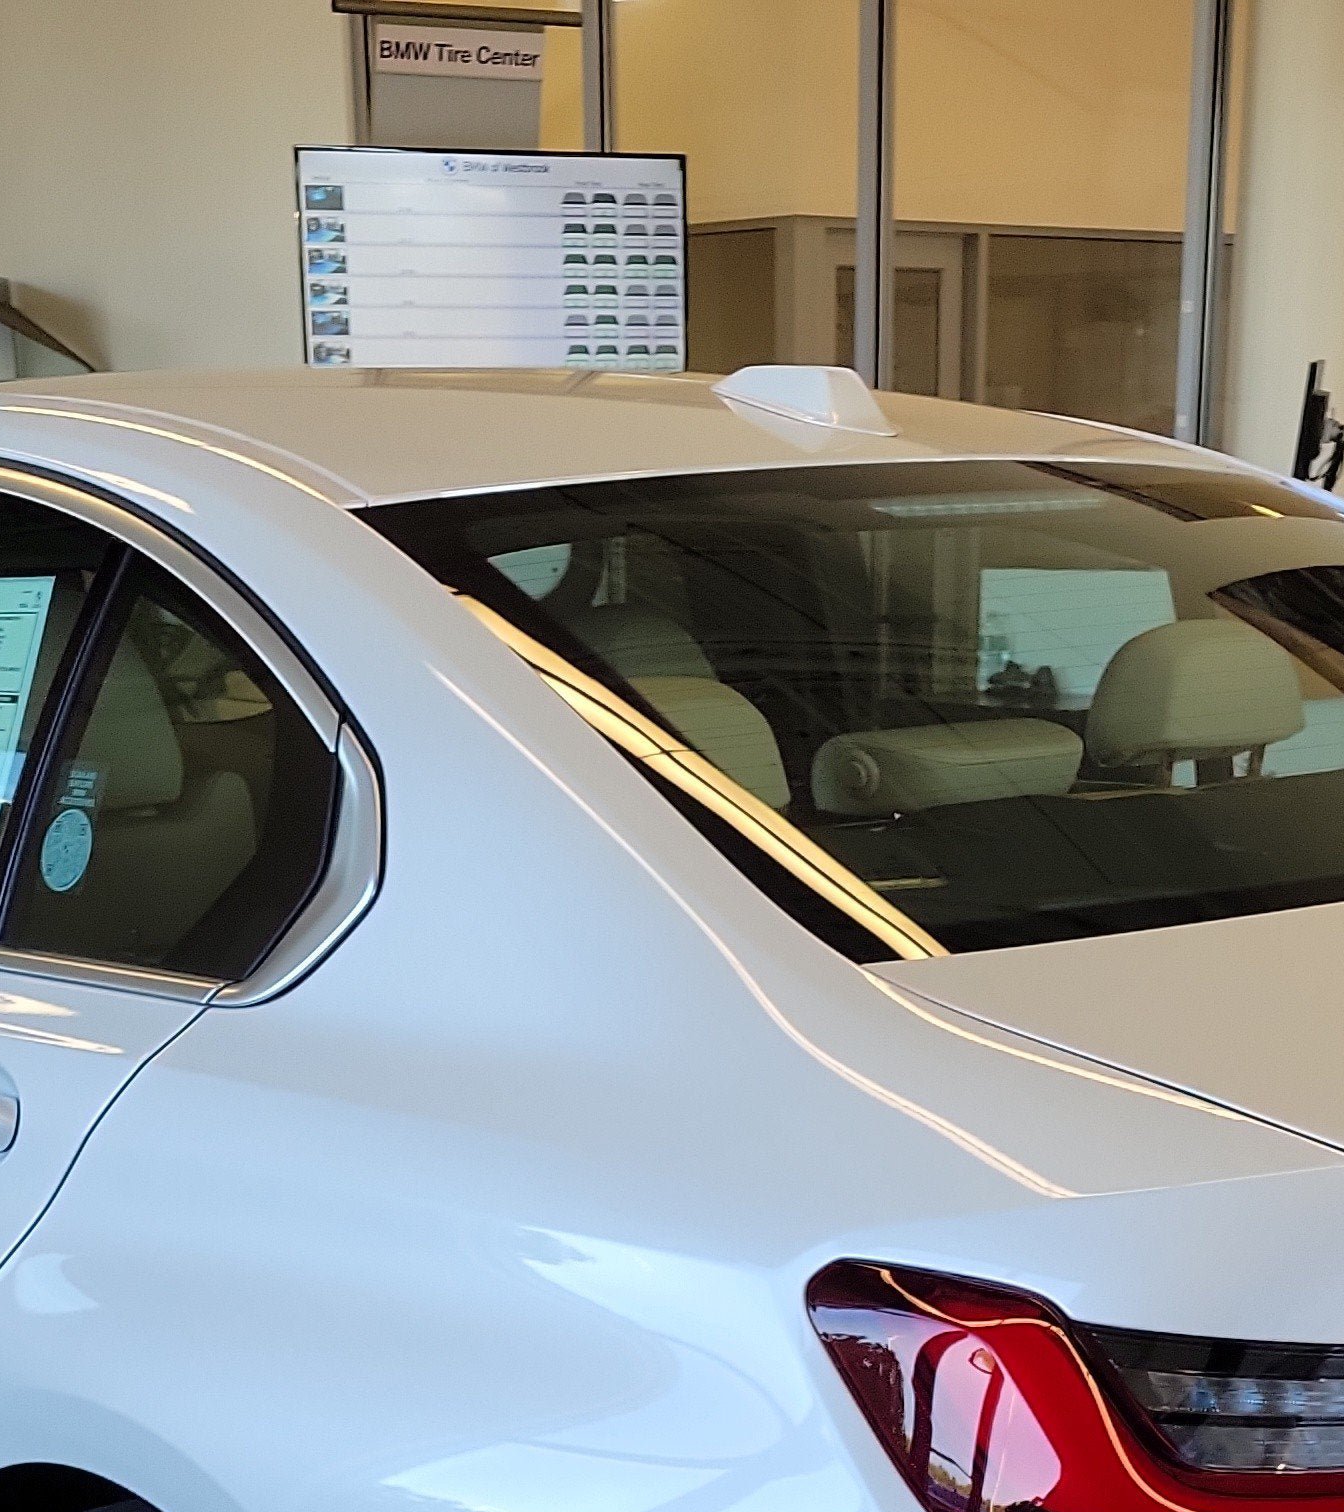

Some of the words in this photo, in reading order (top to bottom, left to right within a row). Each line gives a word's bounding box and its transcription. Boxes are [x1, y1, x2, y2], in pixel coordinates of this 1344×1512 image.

[379, 39, 431, 61] BMW
[433, 42, 472, 63] Tire
[476, 45, 540, 67] Center
